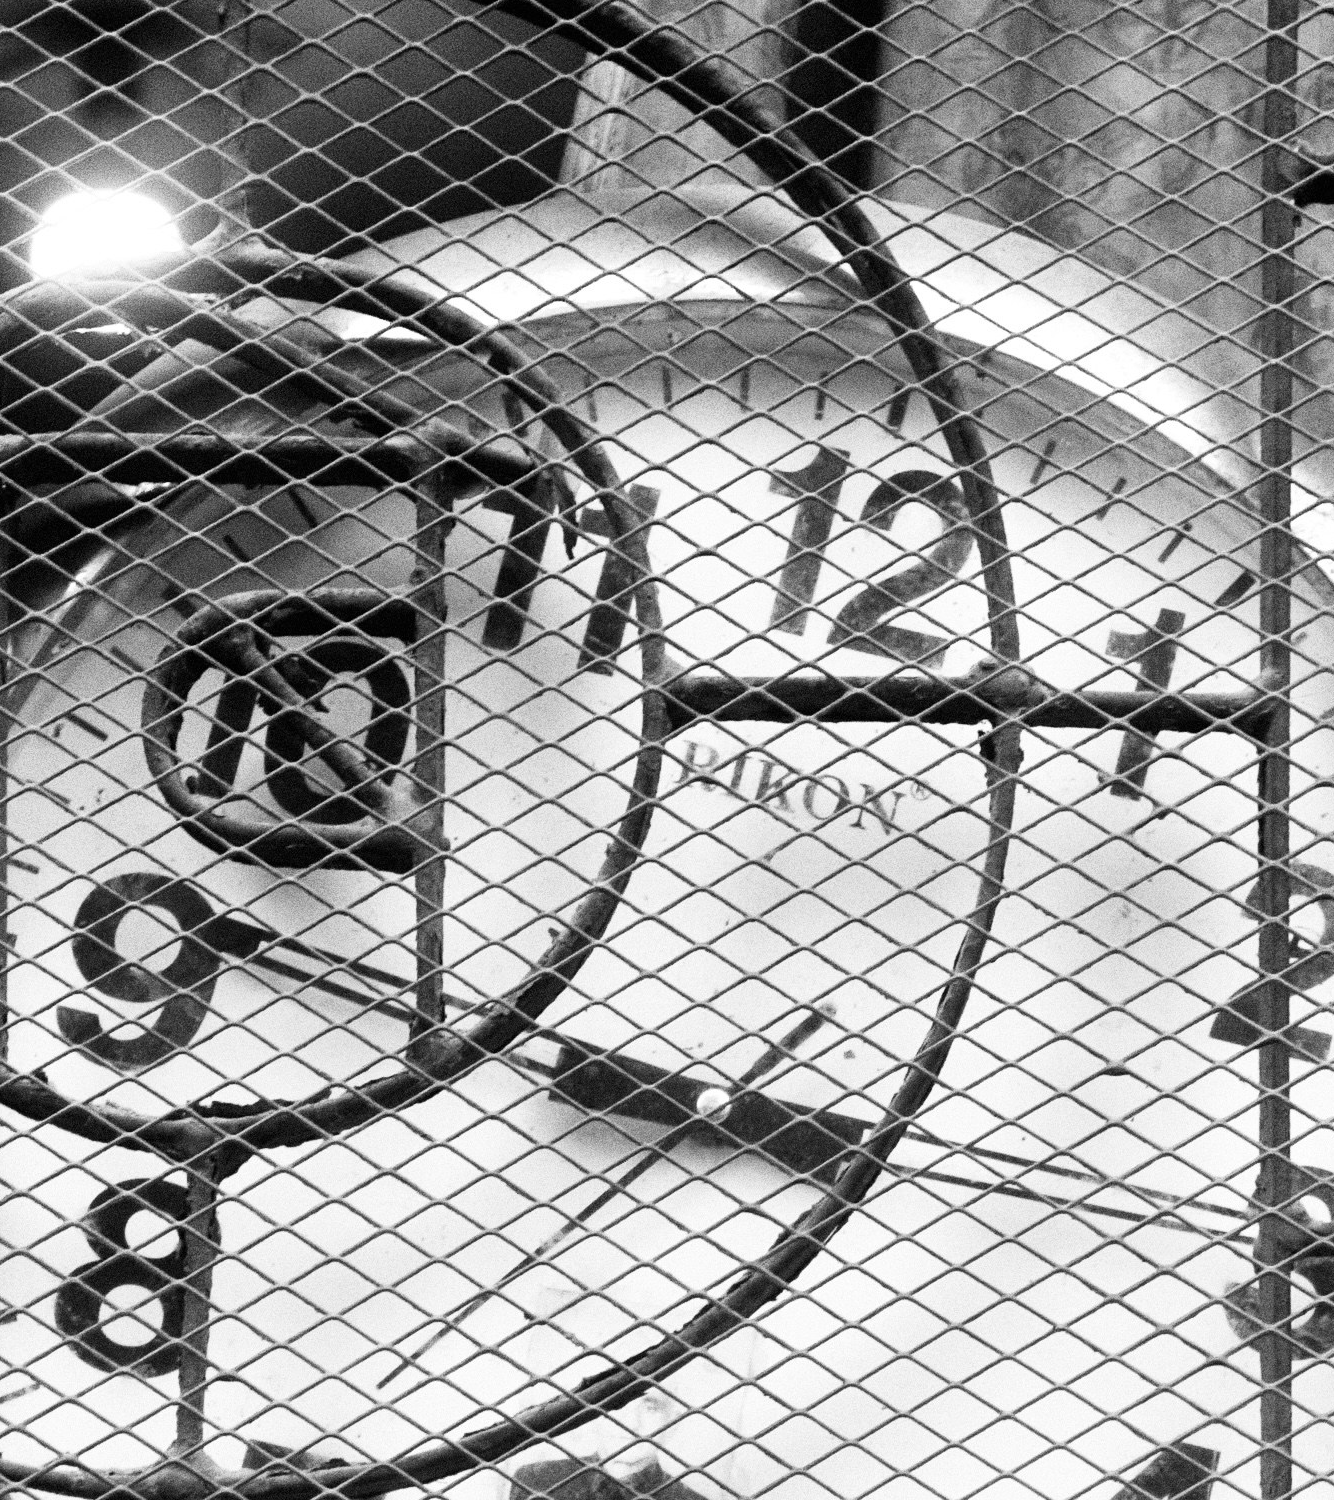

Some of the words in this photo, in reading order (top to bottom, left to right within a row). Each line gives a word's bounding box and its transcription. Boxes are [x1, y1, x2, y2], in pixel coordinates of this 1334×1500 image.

[479, 465, 661, 676] 11
[768, 446, 974, 668] 12
[190, 630, 410, 826] 10
[1105, 608, 1186, 800] 1
[56, 872, 219, 1071] 9
[55, 1178, 220, 1378] 8
